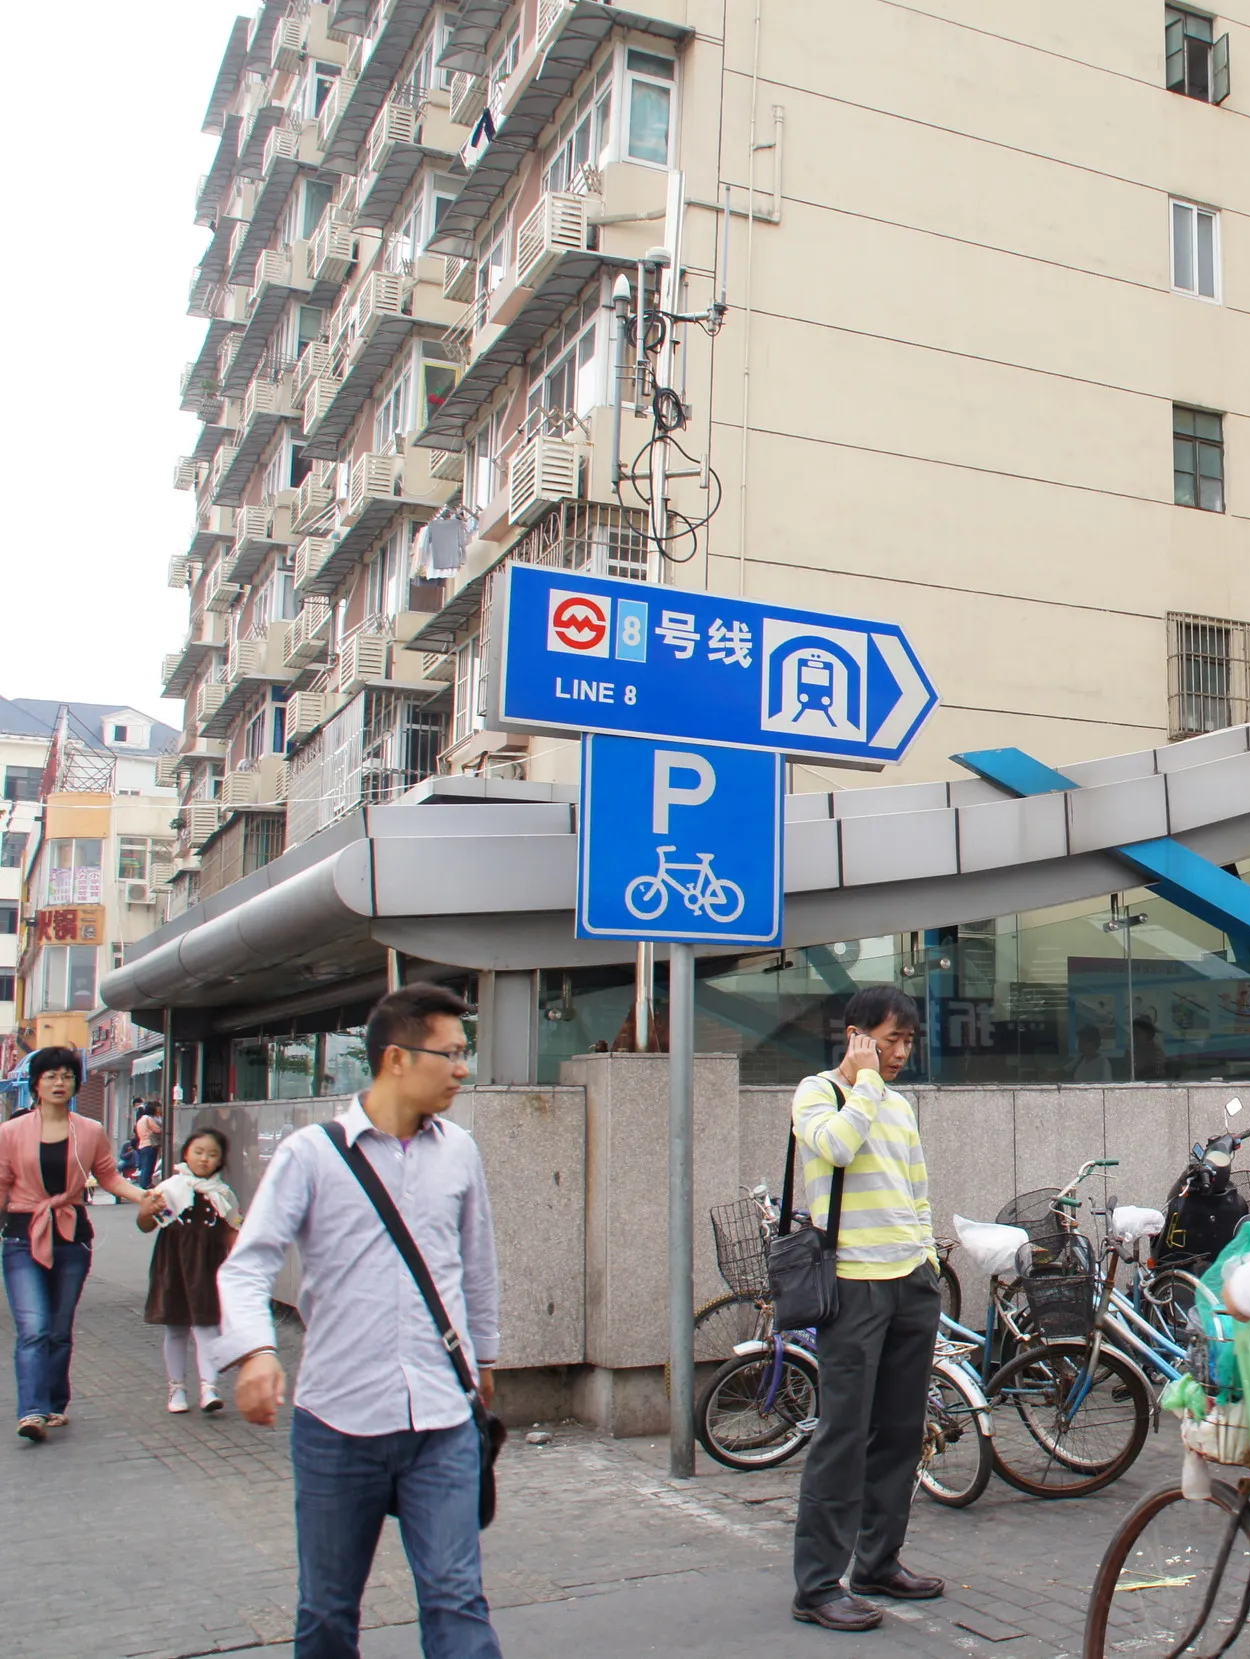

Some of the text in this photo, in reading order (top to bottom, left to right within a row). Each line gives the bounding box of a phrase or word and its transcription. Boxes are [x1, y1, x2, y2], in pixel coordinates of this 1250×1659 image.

[555, 677, 637, 705] LINE 8
[652, 749, 716, 834] P
